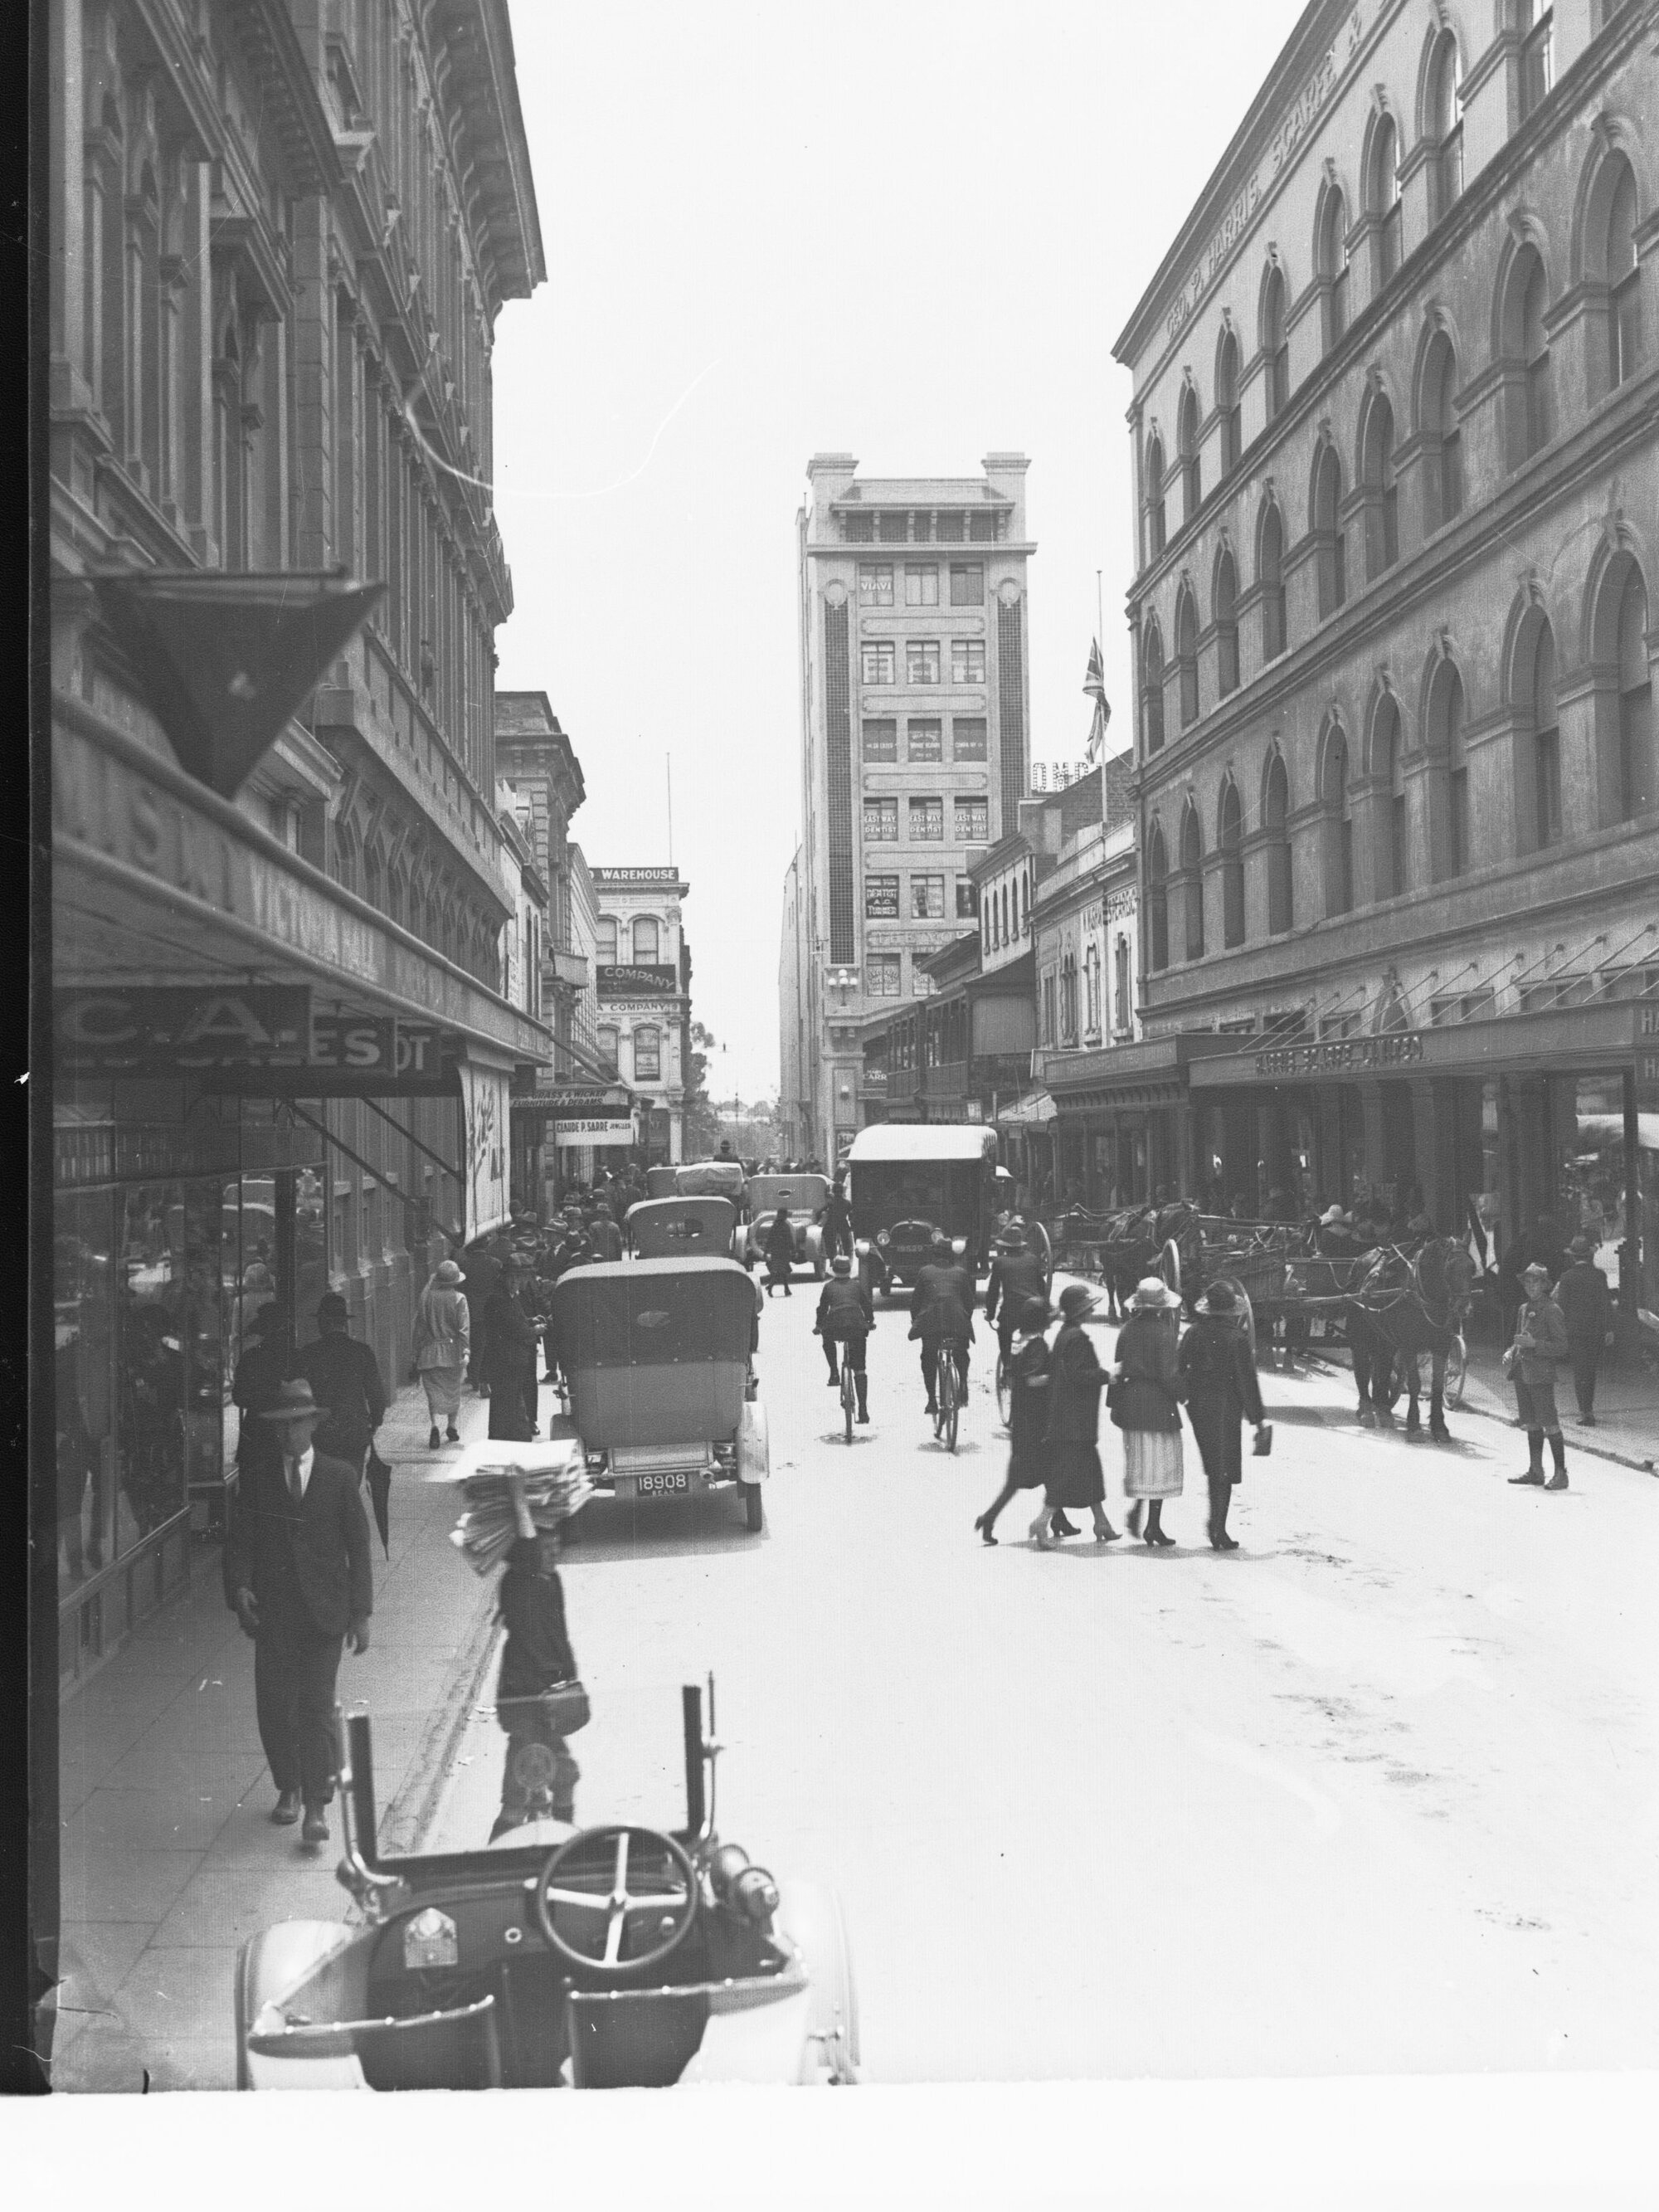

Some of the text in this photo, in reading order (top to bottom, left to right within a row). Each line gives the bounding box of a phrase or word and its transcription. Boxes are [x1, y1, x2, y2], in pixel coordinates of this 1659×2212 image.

[601, 870, 675, 879] WAREHOUSE
[604, 967, 675, 990] COMPANY
[611, 1003, 664, 1012] COMPANY
[573, 1089, 607, 1098] WICKER
[513, 1099, 560, 1108] FURNITURE
[557, 1123, 579, 1133] CLAUDE
[639, 1474, 686, 1491] 18908
